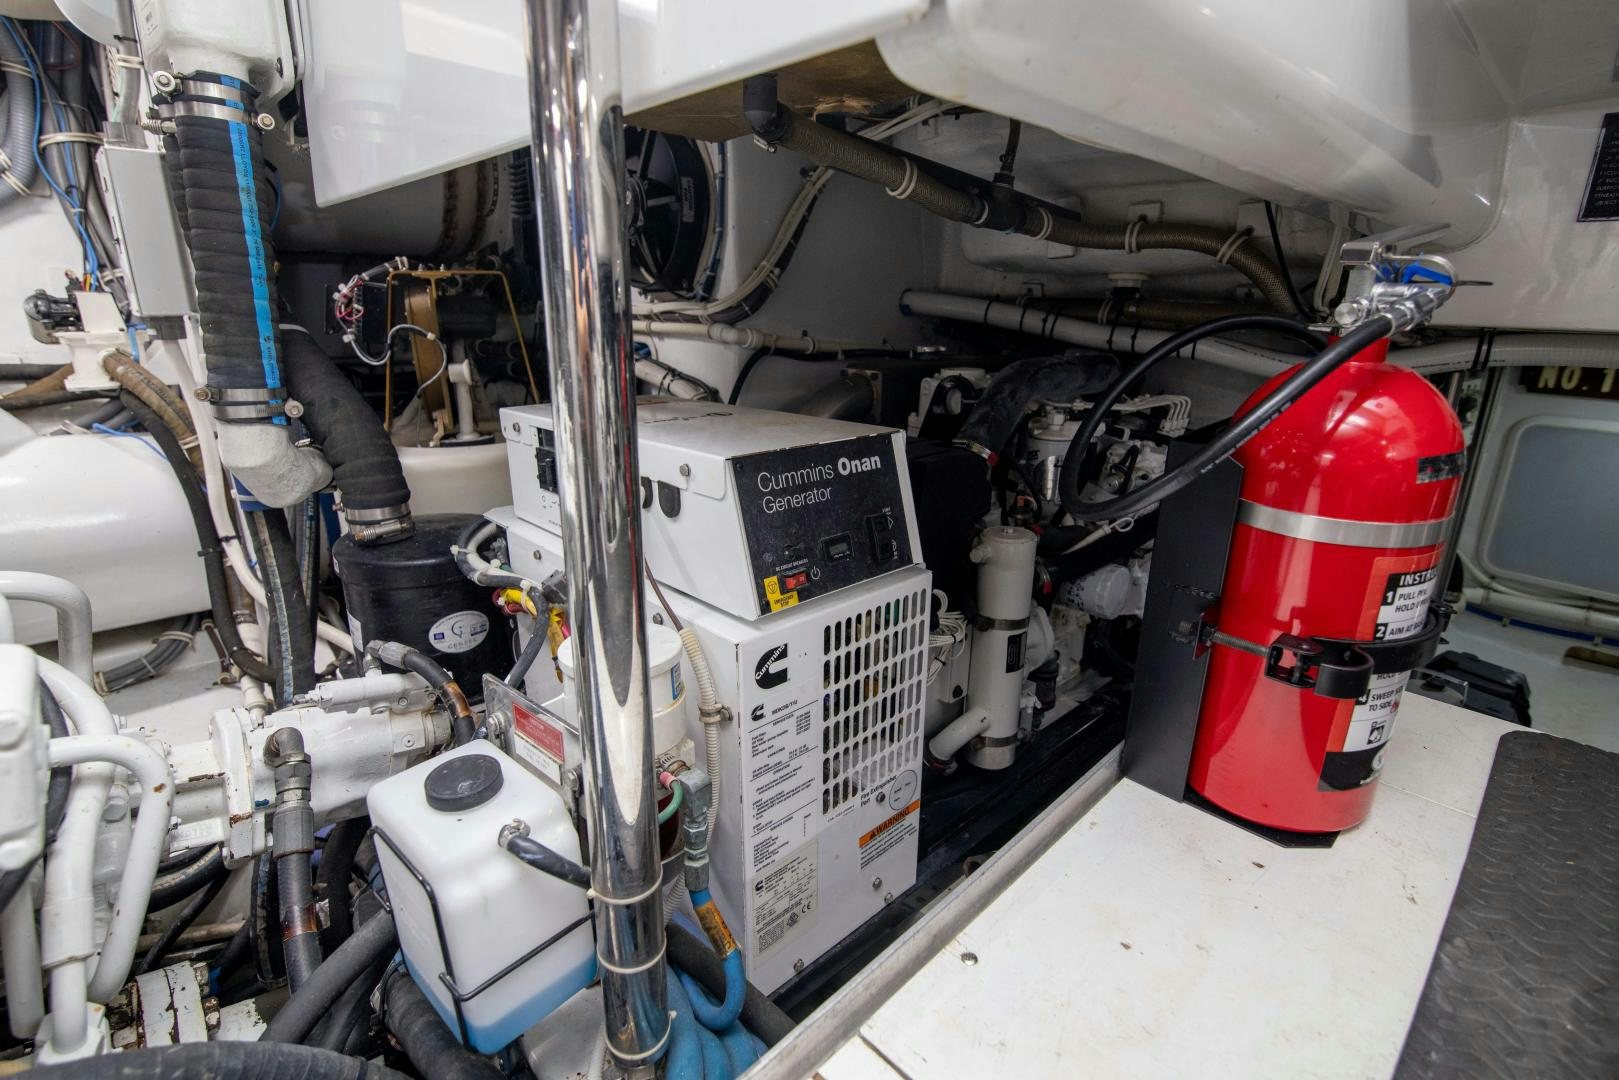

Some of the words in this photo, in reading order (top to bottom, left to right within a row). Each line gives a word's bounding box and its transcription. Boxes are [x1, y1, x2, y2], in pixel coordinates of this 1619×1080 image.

[757, 463, 834, 492] Cummins
[837, 455, 882, 476] Onan
[762, 487, 832, 514] Generator
[1386, 591, 1396, 603] 1
[1398, 592, 1416, 602] PULL
[1394, 602, 1416, 613] HOLD
[1375, 626, 1387, 638] 2
[1389, 626, 1405, 637] AIM
[755, 645, 785, 680] Cummins
[1371, 690, 1394, 702] SWEEP
[1368, 704, 1377, 712] TO
[860, 792, 870, 801] Fire
[870, 774, 897, 795] Extinguisher
[860, 797, 871, 807] Port
[877, 806, 910, 835] WARNING
